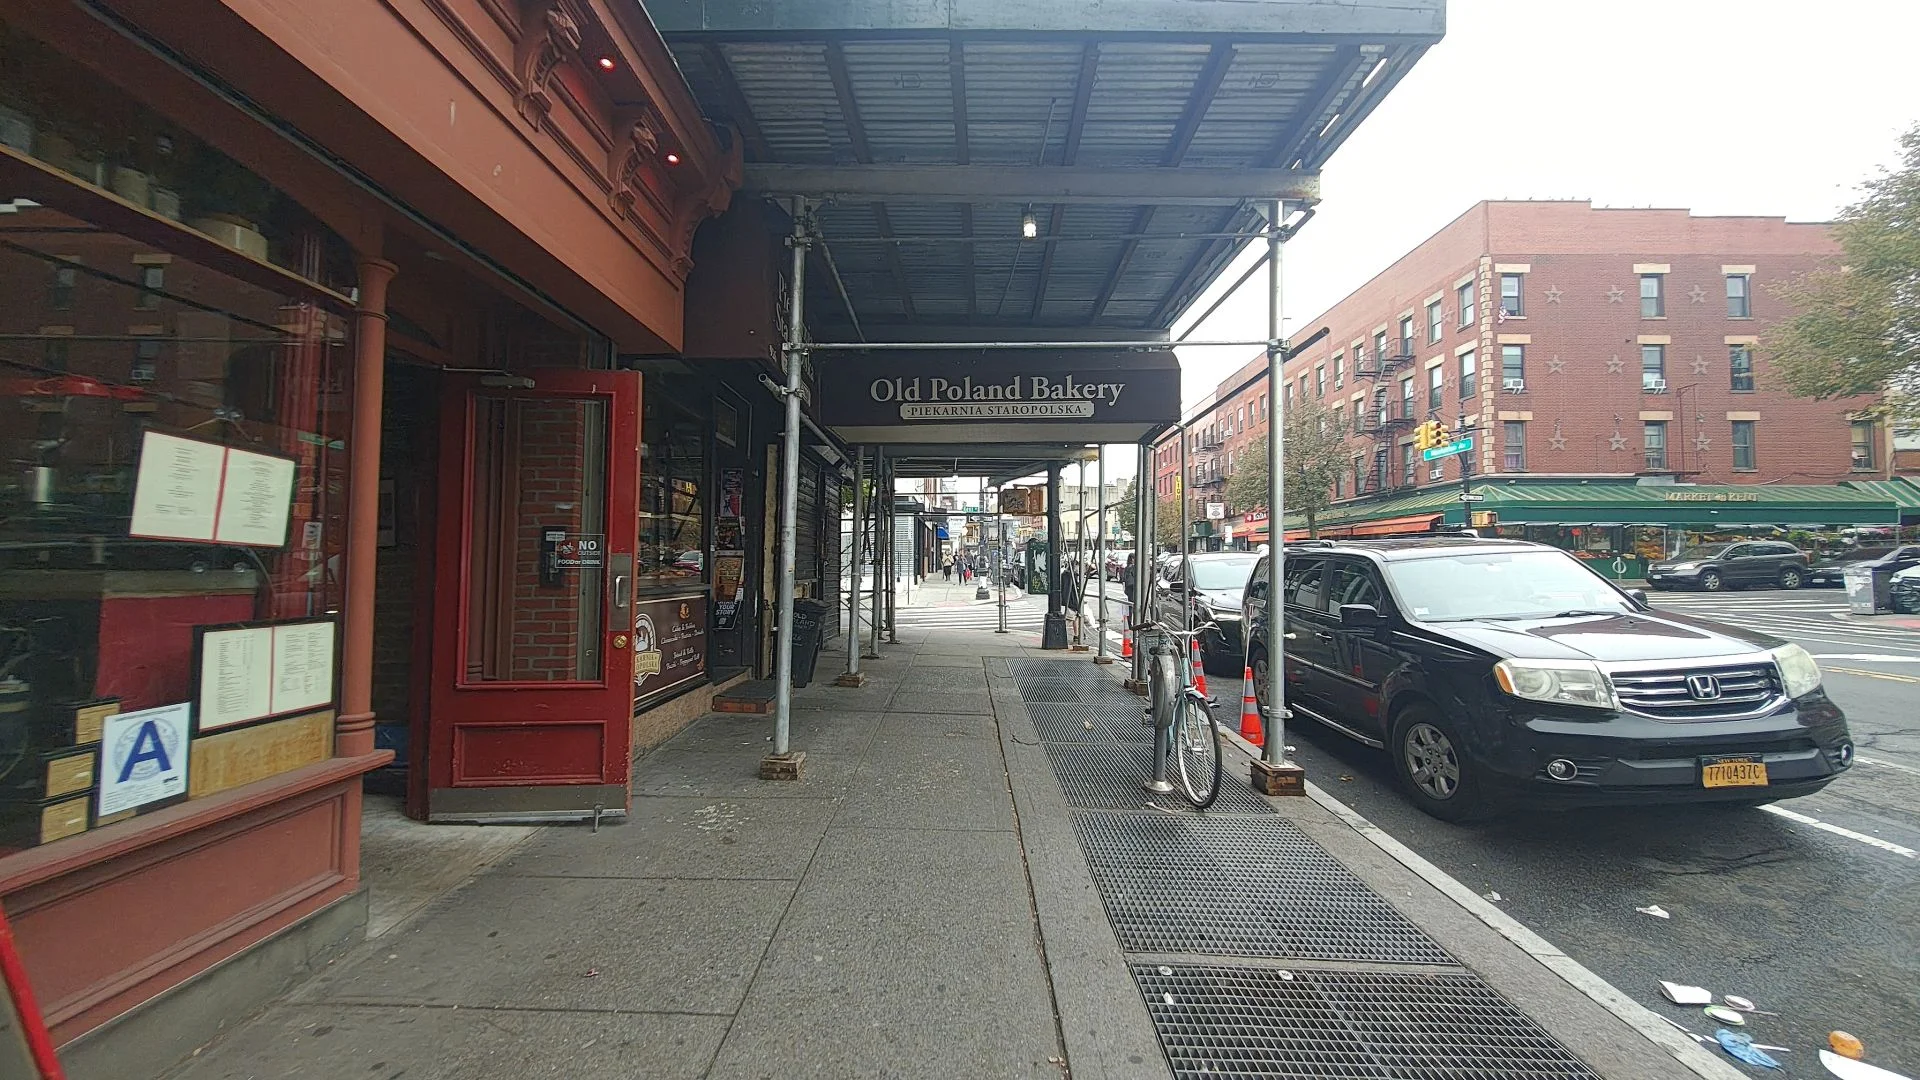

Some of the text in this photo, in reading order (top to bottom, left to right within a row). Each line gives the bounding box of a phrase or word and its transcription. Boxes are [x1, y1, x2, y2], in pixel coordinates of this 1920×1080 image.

[870, 374, 1126, 407] Old Poland Bakery
[910, 404, 1083, 416] PIEKARNIA STAROPOLSKA
[578, 540, 597, 550] NO
[115, 720, 173, 785] A
